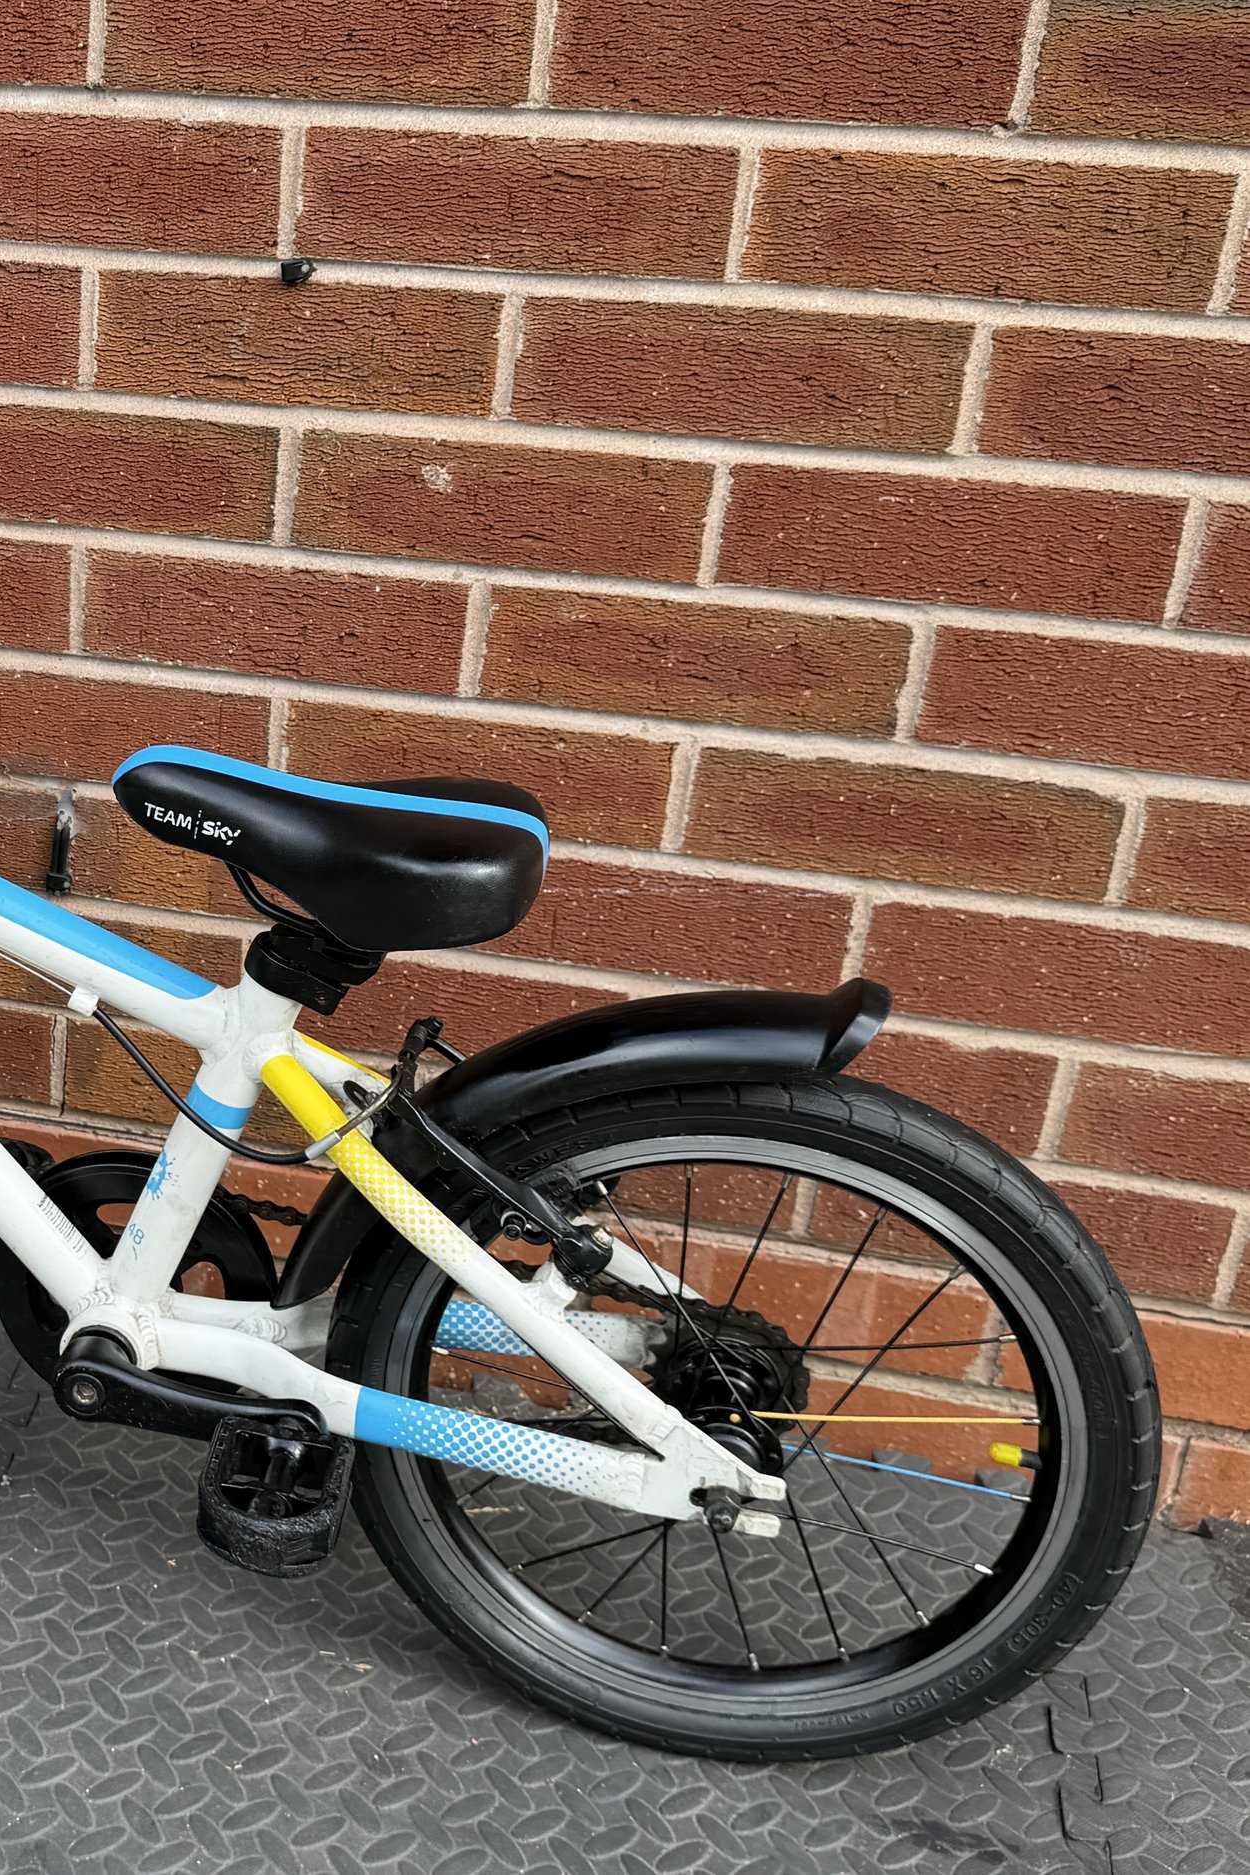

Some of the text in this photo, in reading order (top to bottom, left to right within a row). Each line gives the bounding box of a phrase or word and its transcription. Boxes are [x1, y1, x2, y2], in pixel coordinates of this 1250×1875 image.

[144, 801, 193, 831] TEAM
[967, 1656, 996, 1681] 16
[893, 1687, 941, 1718] 1.50
